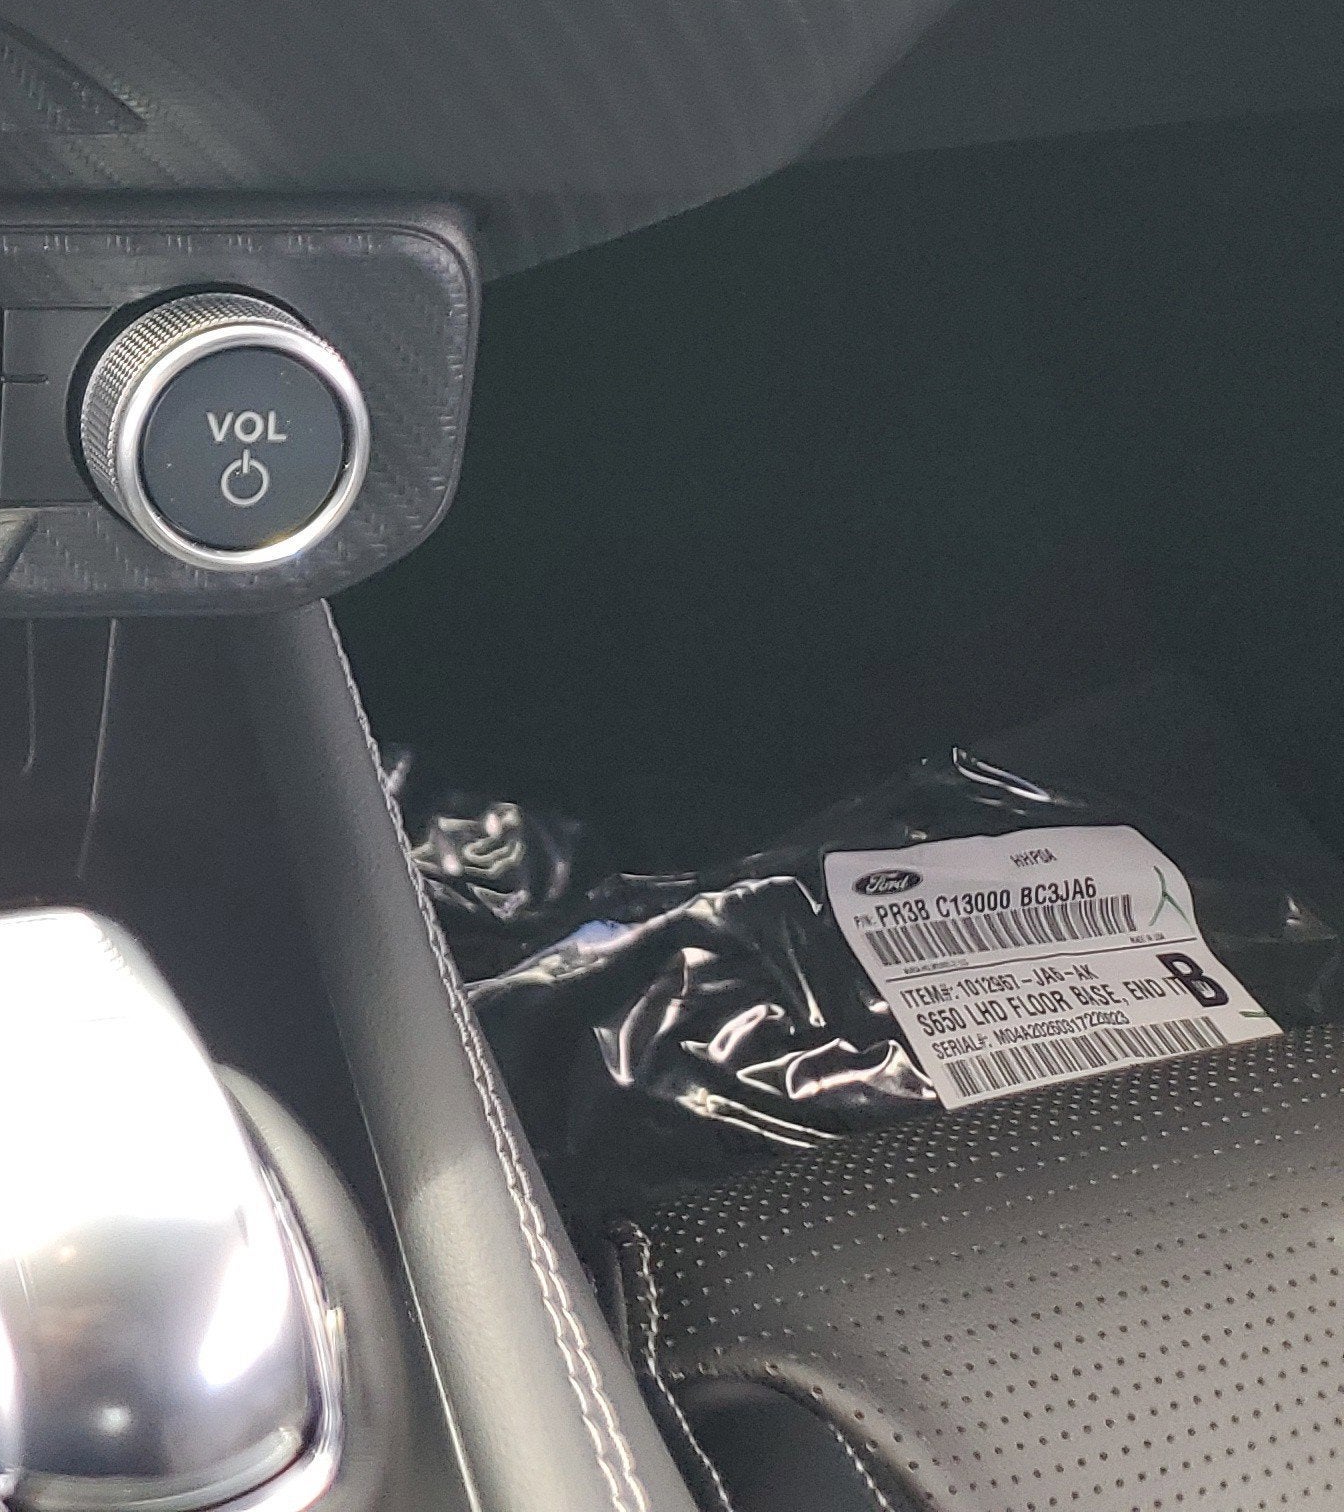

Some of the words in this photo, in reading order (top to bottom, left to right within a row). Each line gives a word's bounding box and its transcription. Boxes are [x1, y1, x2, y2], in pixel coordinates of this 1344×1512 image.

[207, 411, 287, 443] VOL
[875, 897, 931, 928] PR3B
[935, 889, 1011, 918] C13000
[1020, 876, 1097, 907] BC3JA6
[1155, 952, 1230, 1008] B
[916, 1007, 967, 1037] S650
[964, 998, 1009, 1027] LHD
[1006, 989, 1074, 1019] FLOOR
[1123, 978, 1166, 1001] END
